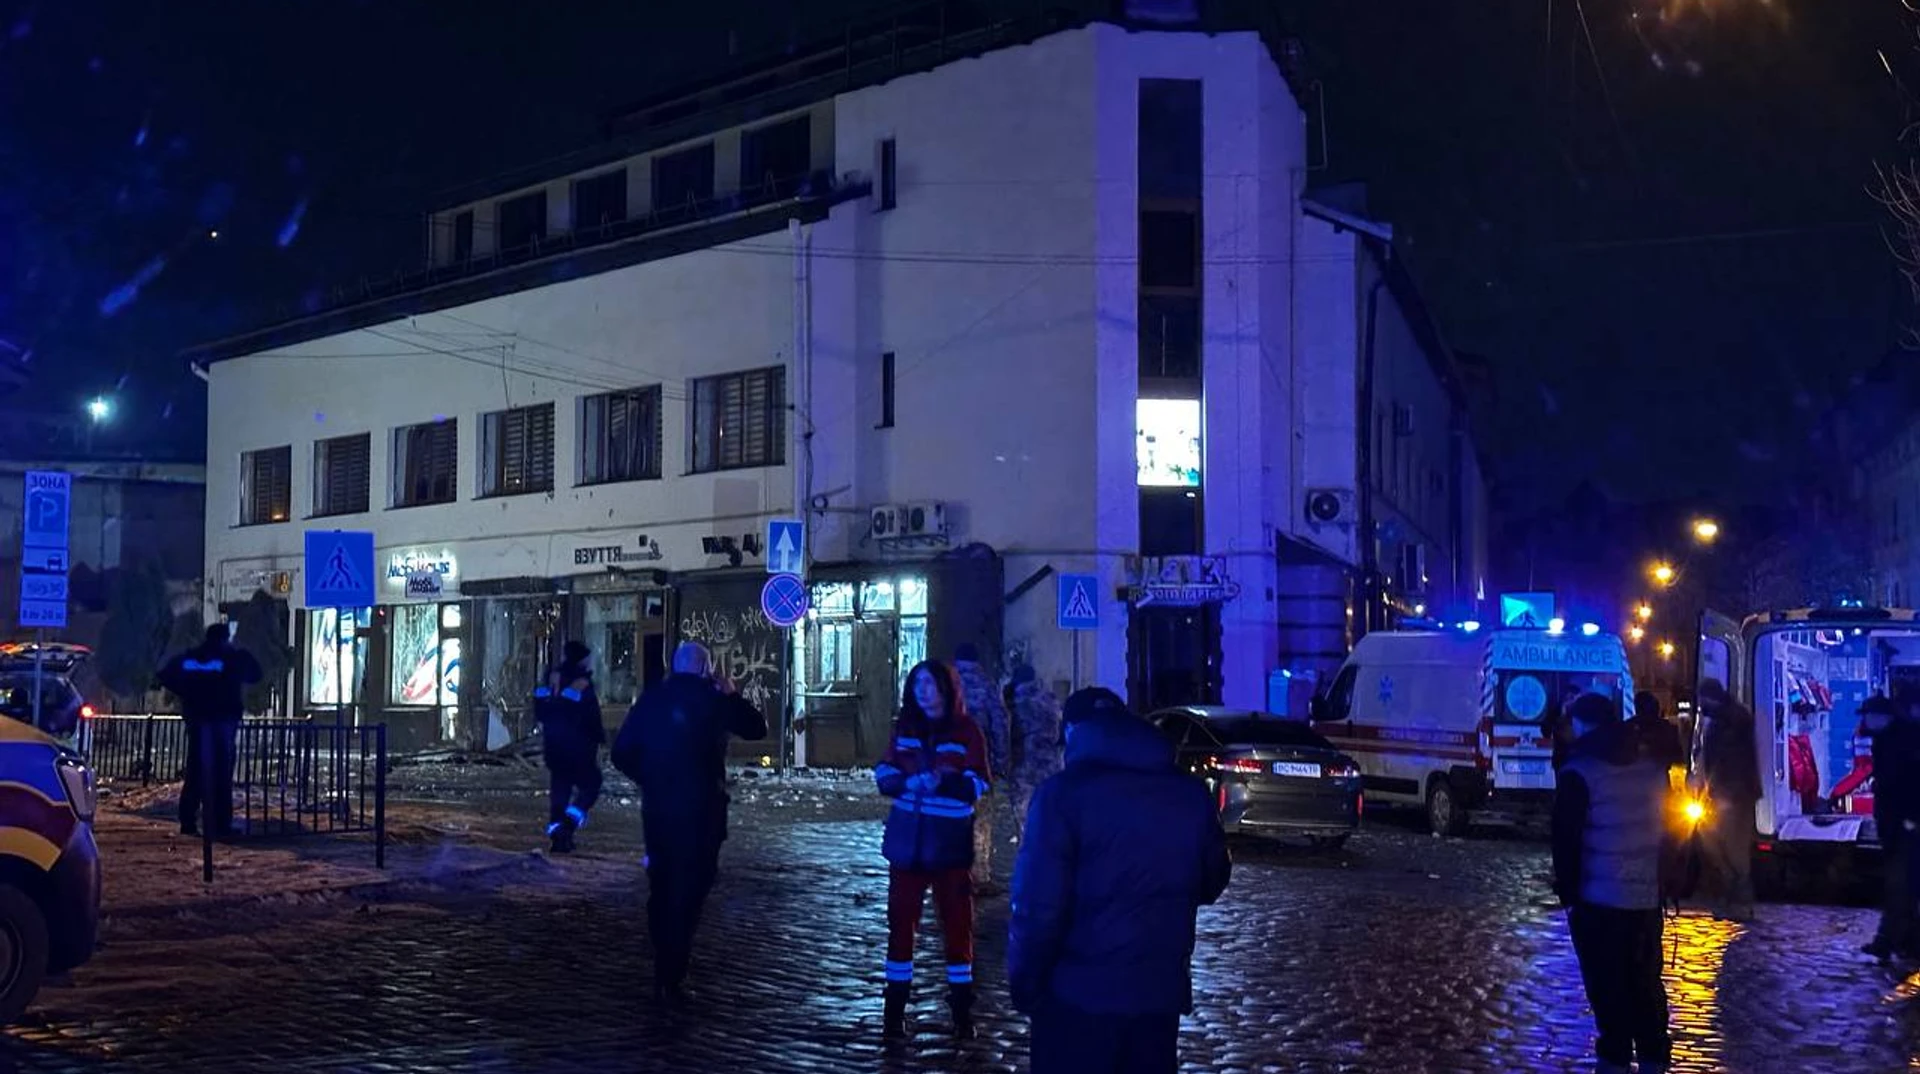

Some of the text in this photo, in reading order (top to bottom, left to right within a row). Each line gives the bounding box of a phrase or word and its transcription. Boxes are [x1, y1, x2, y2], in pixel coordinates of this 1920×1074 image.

[29, 474, 66, 489] ЗОНА
[574, 545, 622, 565] ВЗУТТЯ
[1501, 646, 1613, 666] AMBULANCE
